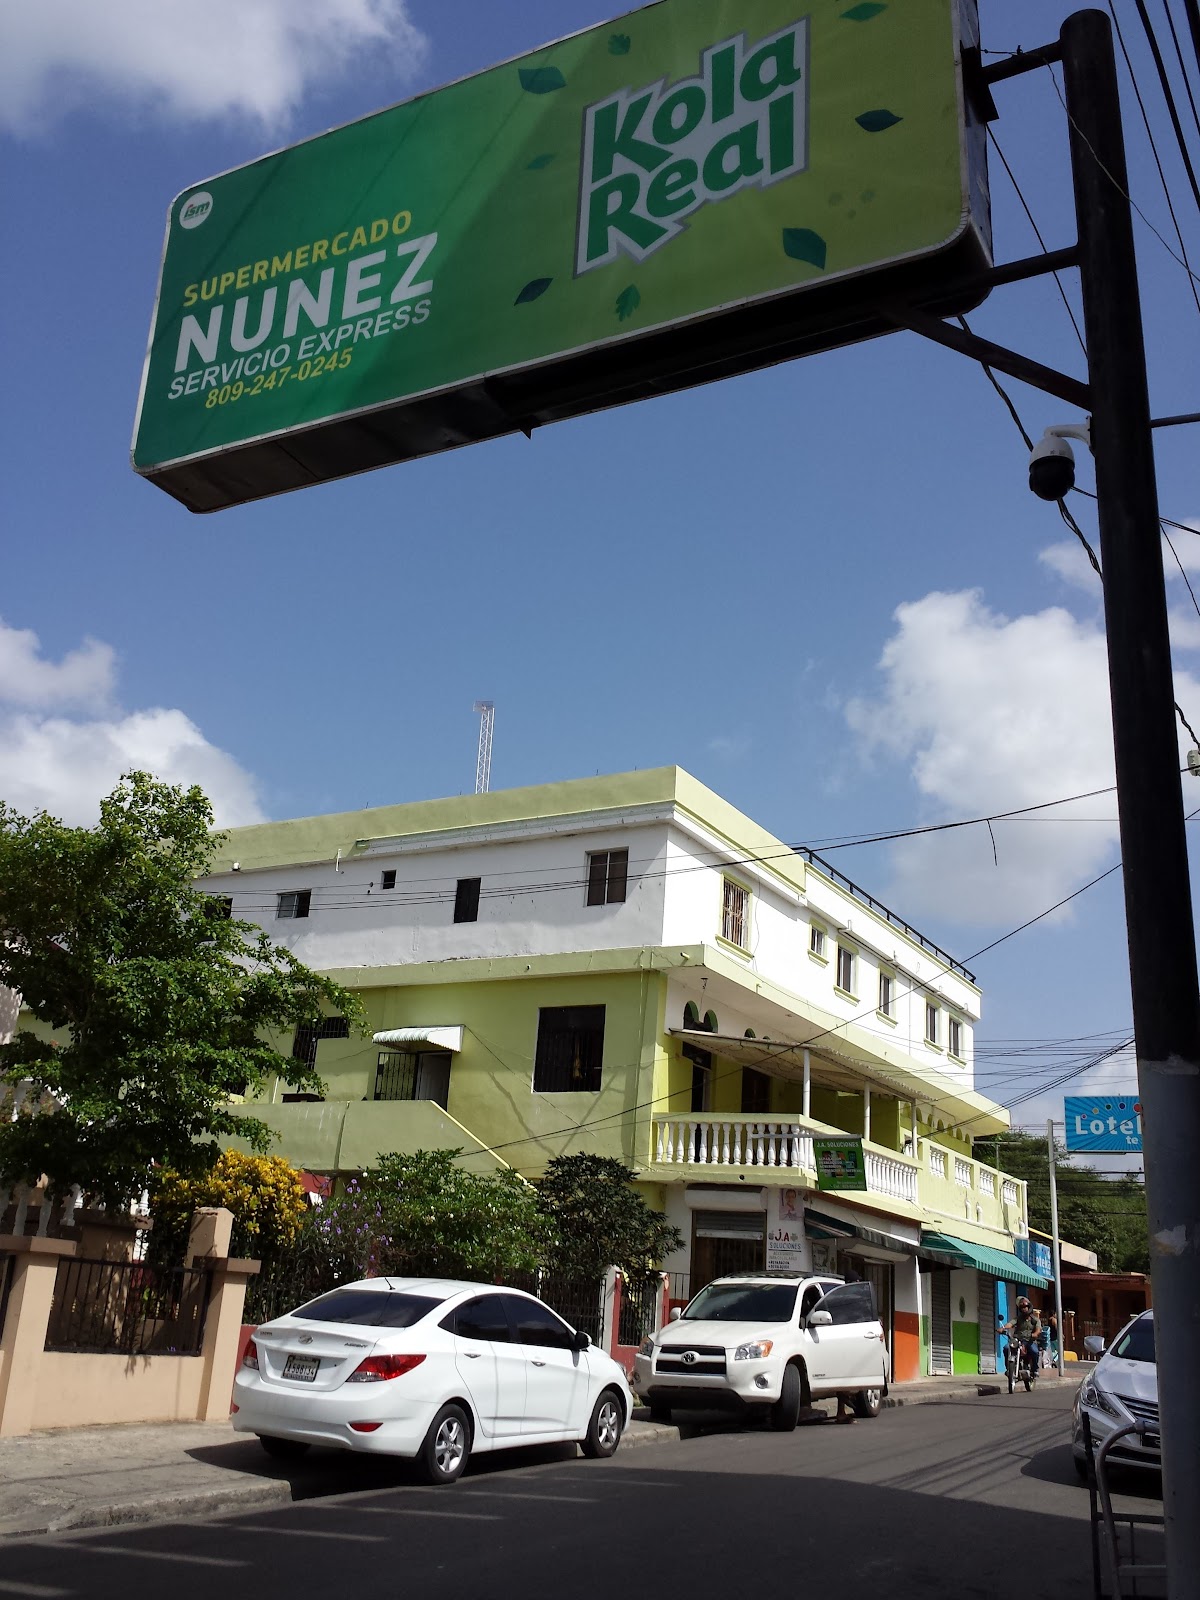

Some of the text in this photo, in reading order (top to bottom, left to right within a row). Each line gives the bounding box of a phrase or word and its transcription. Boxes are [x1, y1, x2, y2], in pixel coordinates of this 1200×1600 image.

[591, 31, 802, 184] Kola
[586, 91, 794, 263] Real
[174, 231, 438, 373] NUNEZ
[183, 210, 412, 307] SUPERMERCADO
[167, 299, 432, 400] SERVICIO EXPRESS
[205, 347, 353, 409] 809-247-0245
[1075, 1115, 1142, 1135] Lote
[769, 1241, 802, 1250] SOLUCIONES
